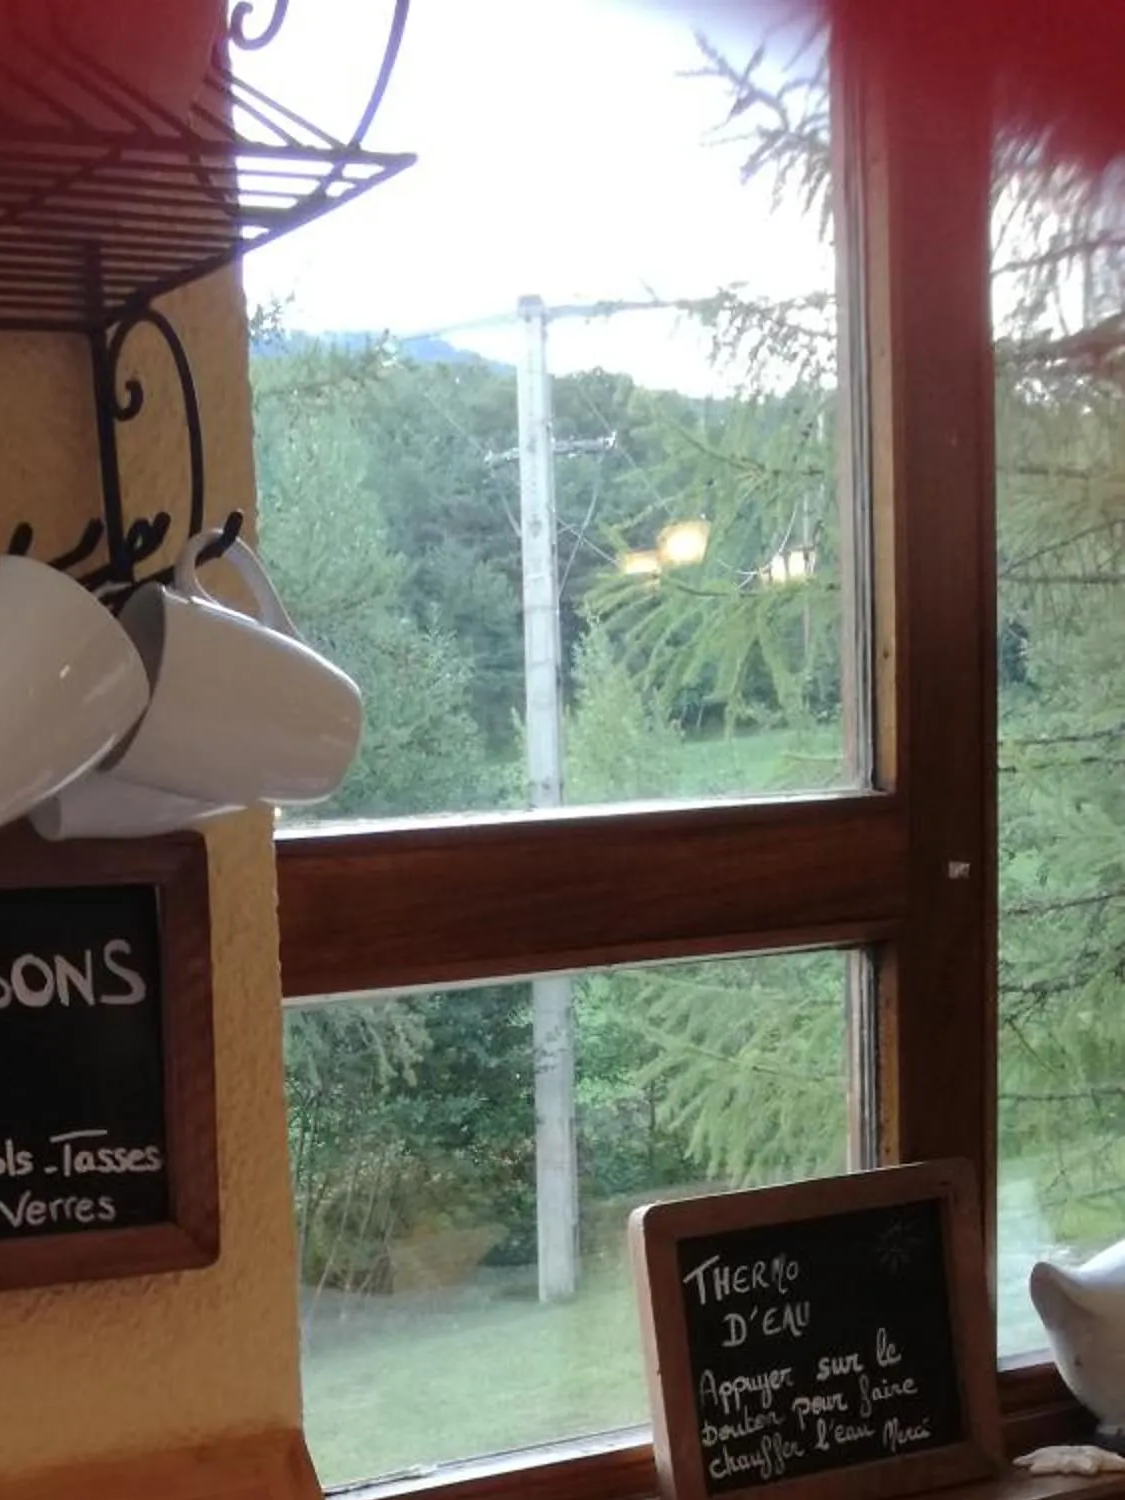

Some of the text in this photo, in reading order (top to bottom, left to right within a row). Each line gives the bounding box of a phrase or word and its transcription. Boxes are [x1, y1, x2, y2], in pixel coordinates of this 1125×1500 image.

[816, 1353, 865, 1382] sur
[876, 1327, 903, 1366] le
[790, 1392, 849, 1431] pour
